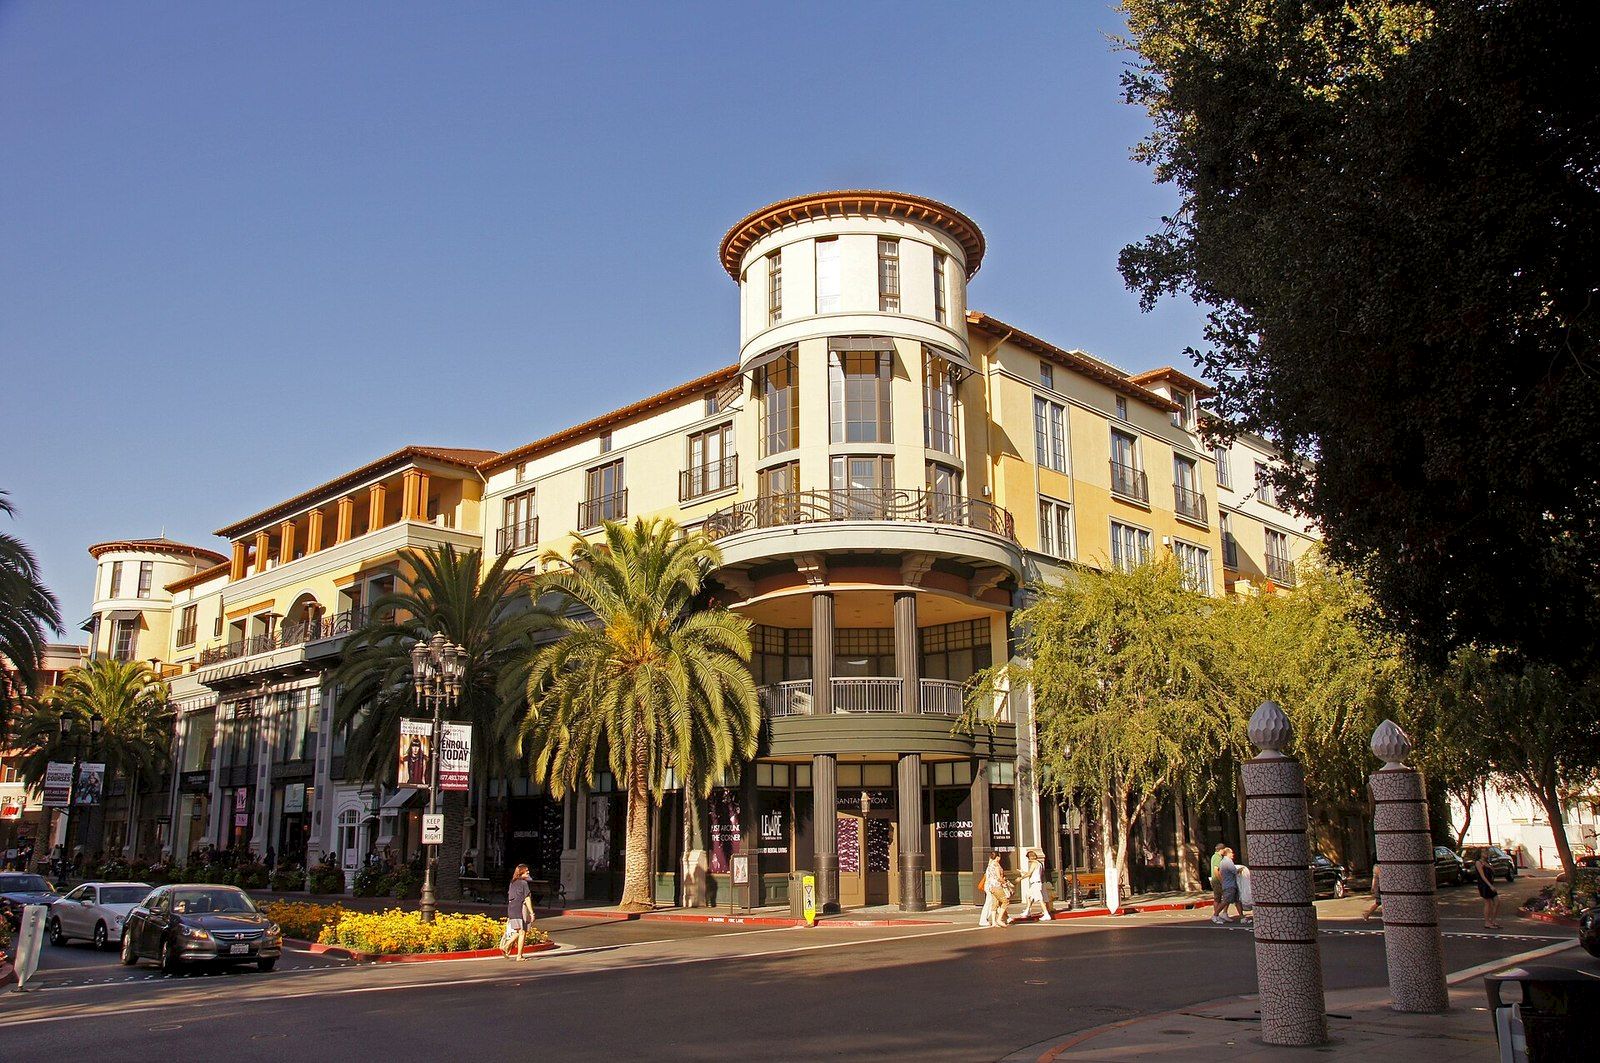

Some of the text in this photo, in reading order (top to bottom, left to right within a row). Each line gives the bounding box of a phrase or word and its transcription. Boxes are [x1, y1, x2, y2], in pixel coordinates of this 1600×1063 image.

[441, 740, 469, 750] ENROLL
[441, 749, 469, 761] TODAY
[936, 820, 974, 830] JUST AROUND
[711, 833, 741, 841] THE CORNER
[938, 830, 973, 838] THE CORNER
